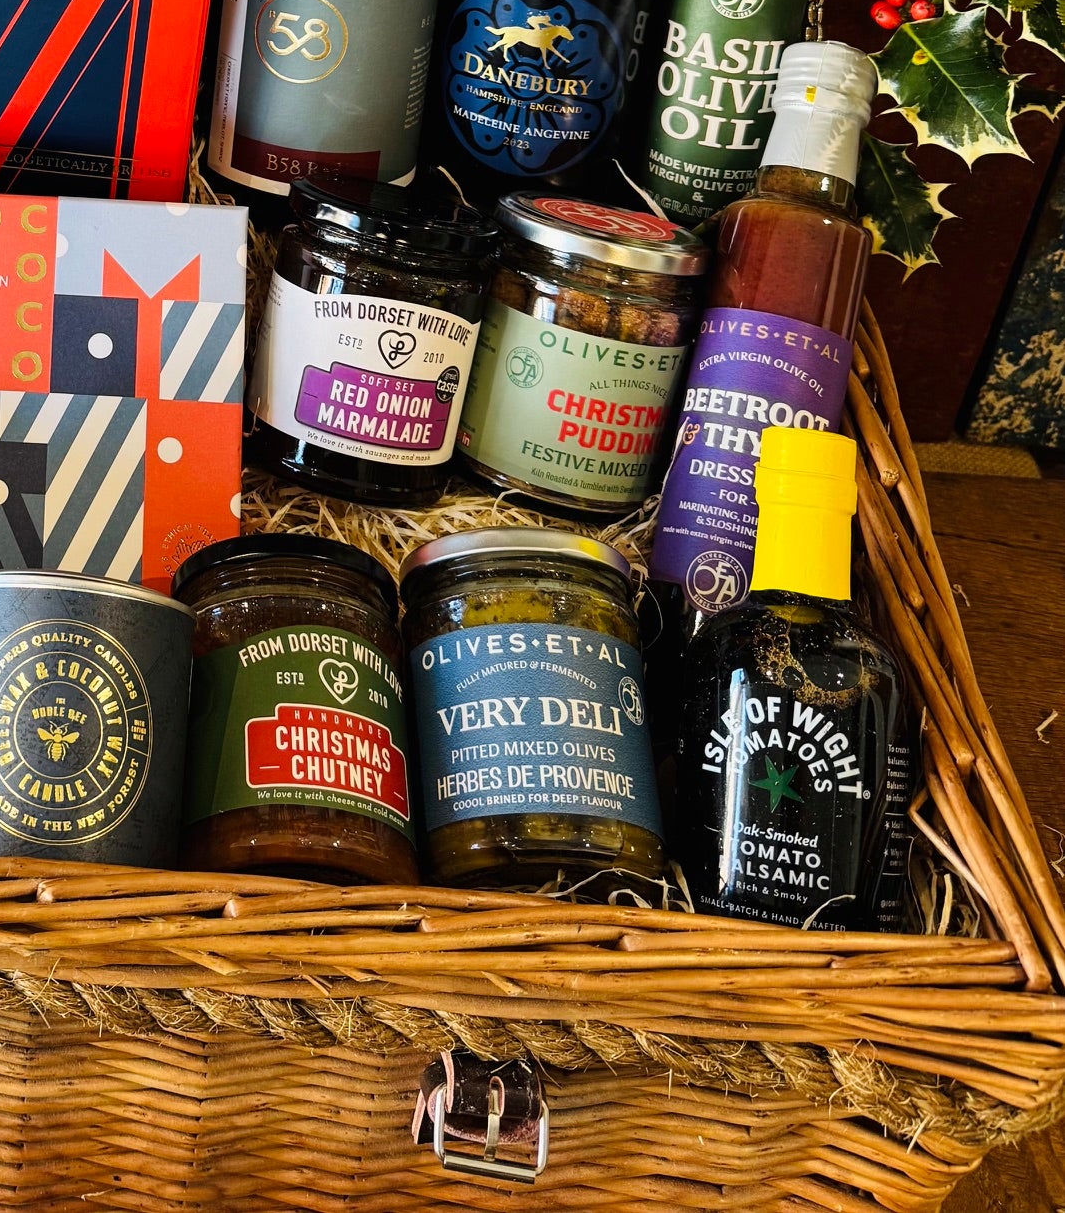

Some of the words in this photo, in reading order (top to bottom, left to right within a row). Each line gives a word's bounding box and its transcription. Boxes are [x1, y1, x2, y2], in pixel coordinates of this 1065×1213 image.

[663, 19, 785, 75] BASIL
[464, 52, 594, 97] DANEBURY
[465, 84, 526, 111] HAMPSHIRE,
[530, 103, 584, 115] ENGLAND
[453, 104, 521, 135] MADELEINE
[523, 126, 591, 141] ANGEVINE
[660, 106, 760, 150] OIL
[502, 137, 530, 151] 2023
[266, 153, 301, 174] B58
[314, 301, 353, 319] FROM
[357, 303, 415, 328] DORSET
[417, 313, 449, 335] WITH
[448, 323, 471, 347] LOVE
[423, 352, 445, 364] 2010
[699, 352, 726, 371] EXTRA
[728, 351, 772, 365] VIRGIN
[773, 359, 808, 383] OLIVE
[808, 379, 824, 398] OIL
[330, 380, 370, 408] RED
[375, 391, 433, 419] ONION
[360, 374, 390, 387] SOFT
[395, 381, 415, 393] SET
[317, 403, 433, 445] MARMALADE
[683, 388, 830, 431] BEETROOT
[521, 440, 595, 473] FESTIVE
[598, 461, 647, 477] MIXED
[31, 632, 93, 648] QUALITY
[94, 644, 139, 700] CANDLES
[57, 659, 122, 725] COCONUT
[368, 688, 388, 709] 2010
[294, 710, 382, 739] HANDMADE
[437, 696, 530, 736] VERY
[538, 696, 624, 736] DELI
[275, 725, 391, 773] CHRISTMAS
[451, 743, 500, 764] PITTED
[504, 741, 559, 756] MIXED
[562, 742, 616, 763] OLIVES
[745, 696, 783, 725] OF
[791, 700, 863, 800] WIGHT
[19, 773, 87, 803] CANDLE
[291, 755, 383, 797] CHUTNEY
[437, 767, 503, 801] HERBES
[507, 765, 535, 788] DE
[539, 765, 636, 800] PROVENCE
[257, 790, 271, 799] We
[273, 789, 293, 799] love
[295, 790, 302, 799] it
[304, 791, 324, 801] with
[327, 794, 355, 807] cheese
[357, 799, 372, 811] and
[728, 837, 821, 869] TOMATO
[735, 821, 819, 848] Oak-Smoked
